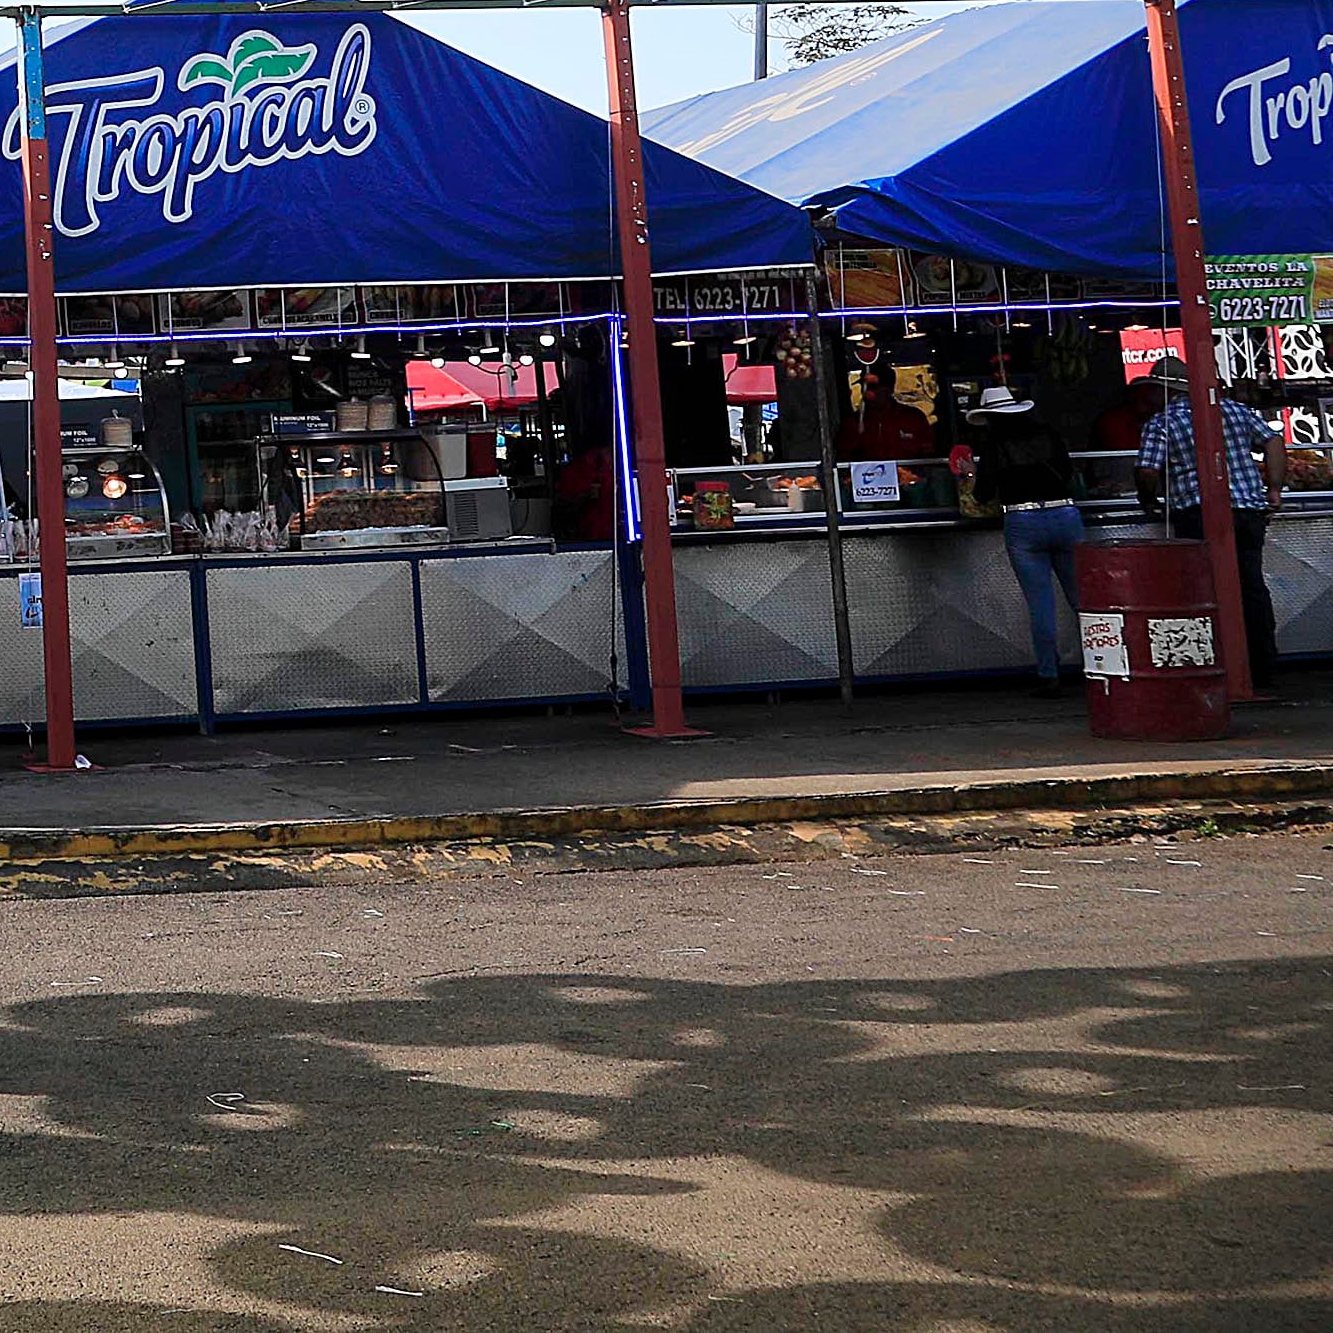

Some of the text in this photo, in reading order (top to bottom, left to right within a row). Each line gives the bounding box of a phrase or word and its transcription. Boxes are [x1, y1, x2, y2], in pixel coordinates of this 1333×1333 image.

[1215, 56, 1333, 166] Trop
[2, 23, 378, 238] Tropical
[1204, 261, 1309, 274] EVENTOS LA
[1206, 276, 1306, 290] CHAVELITA
[1219, 295, 1307, 322] 6223-7271
